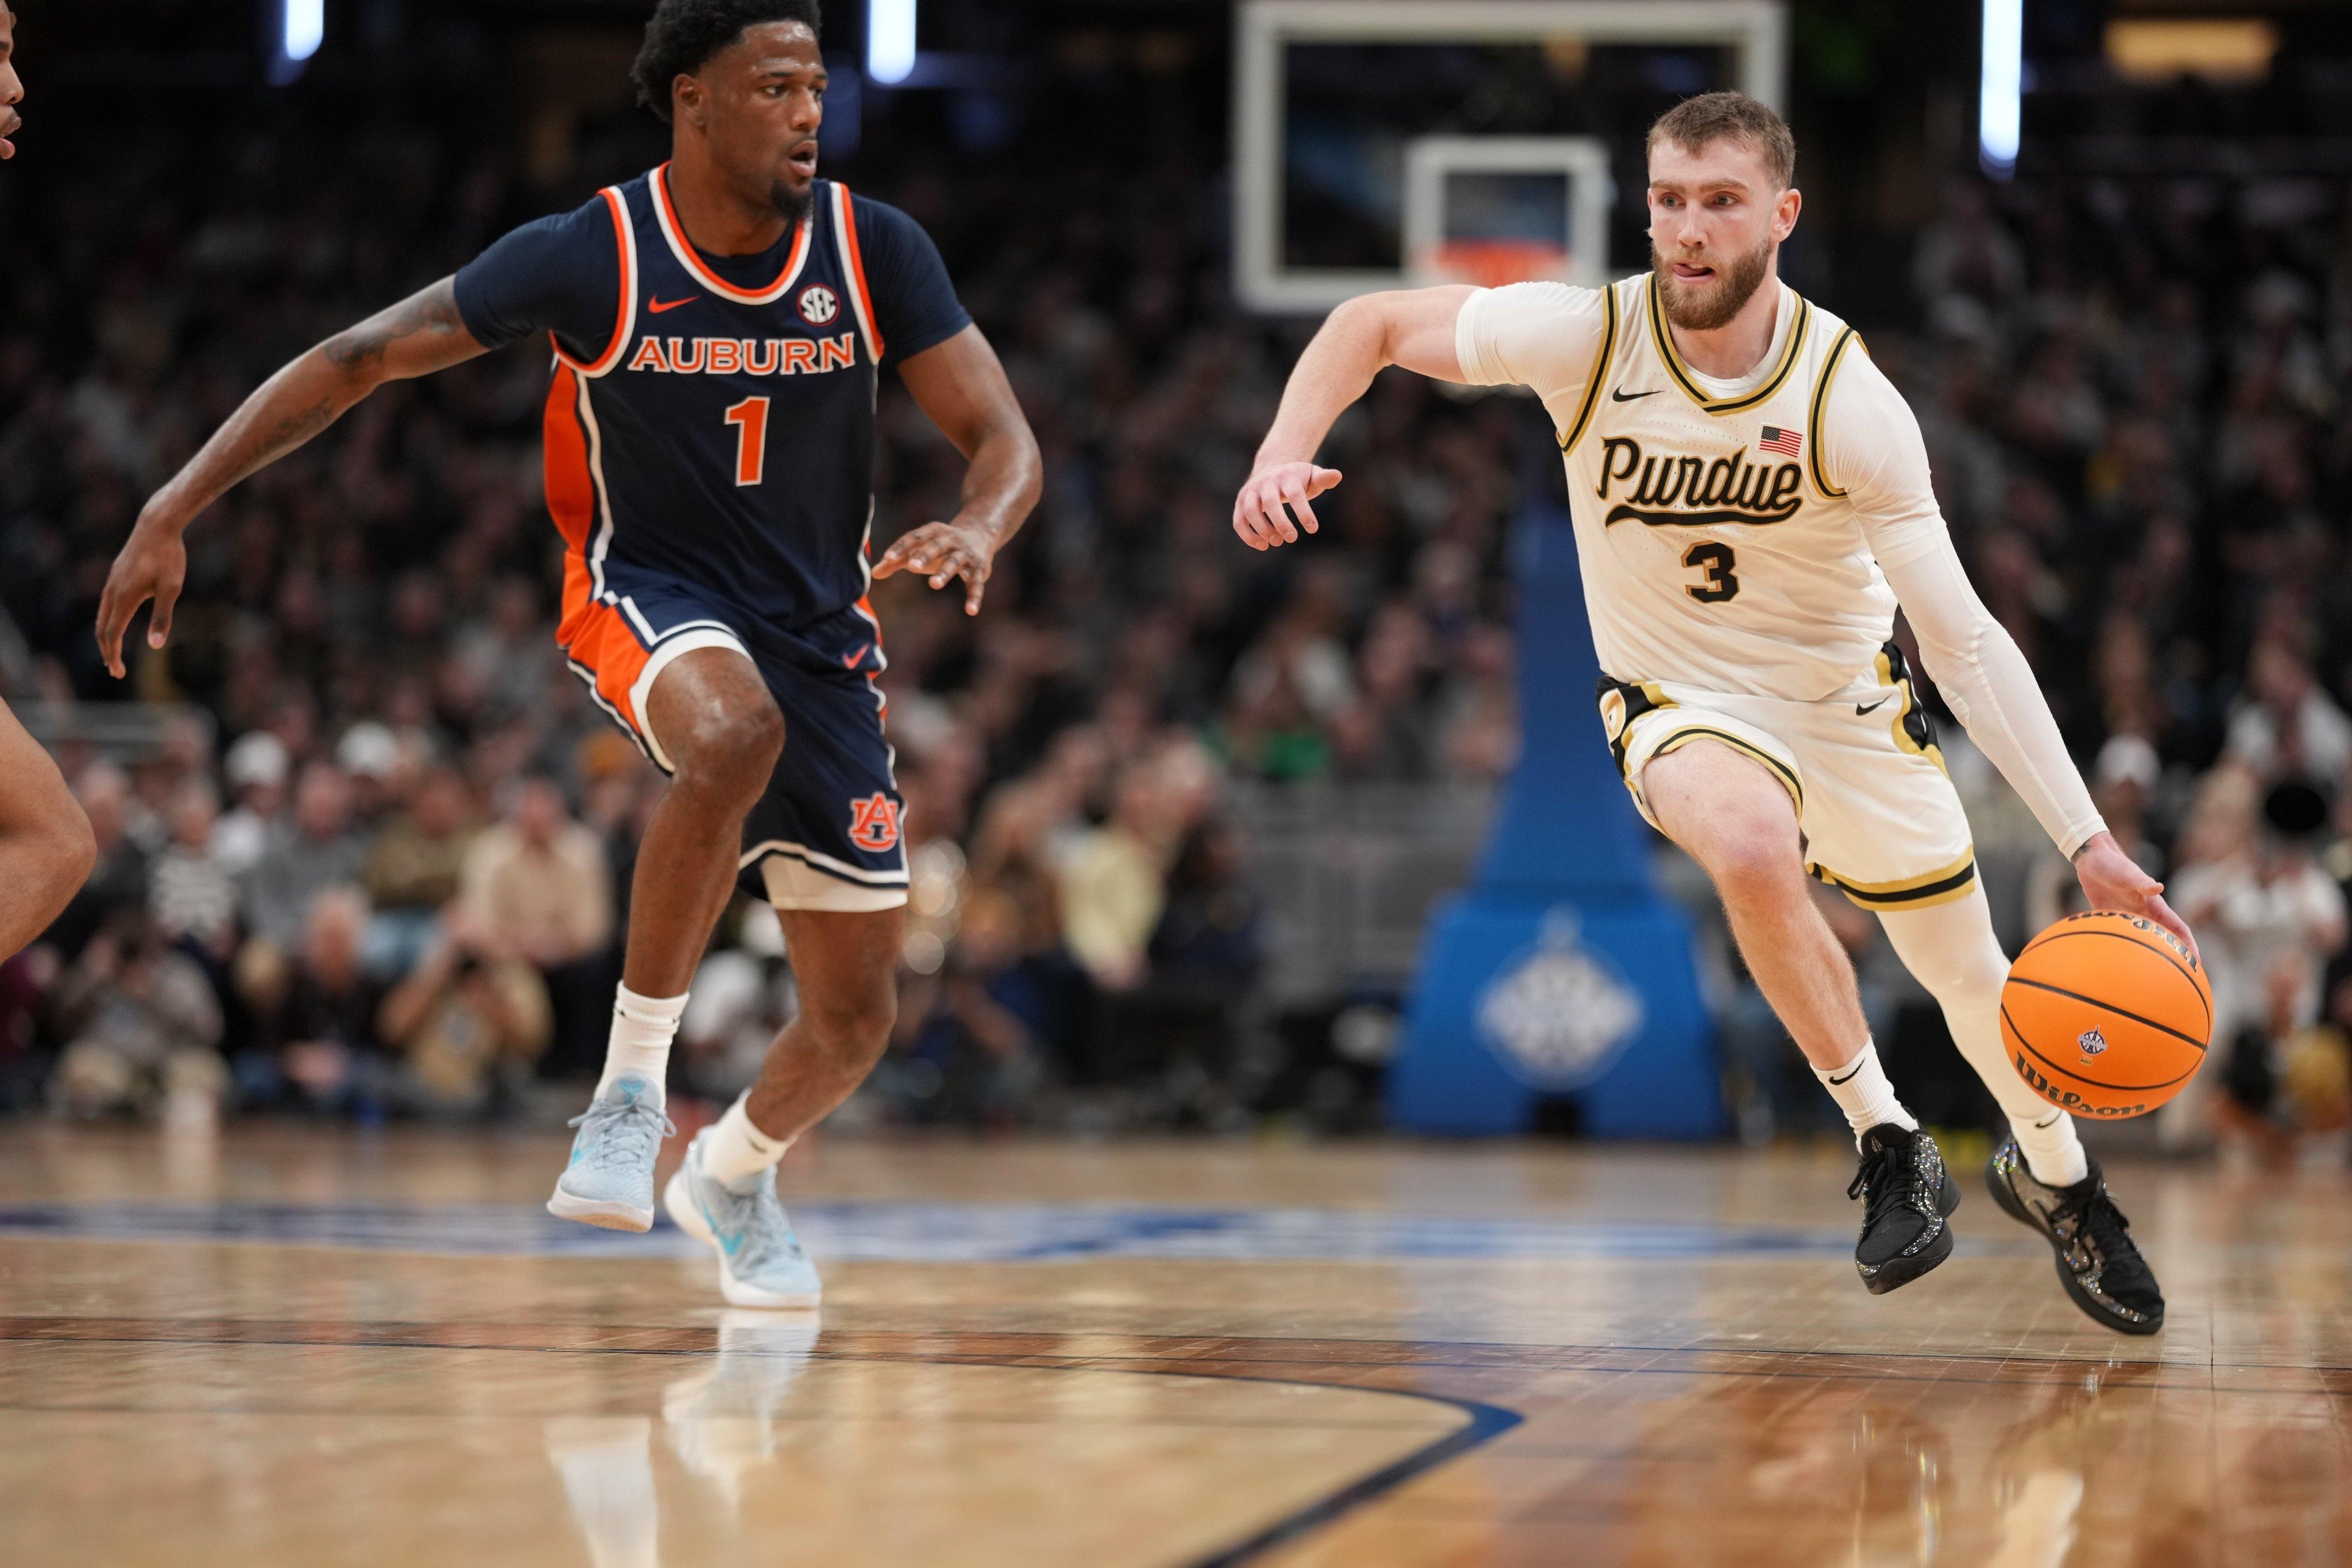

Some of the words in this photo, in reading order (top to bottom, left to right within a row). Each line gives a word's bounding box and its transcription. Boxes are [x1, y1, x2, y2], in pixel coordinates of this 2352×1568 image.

[801, 287, 836, 323] SEC
[627, 331, 856, 374] AUBURN
[724, 396, 771, 487] 1
[1596, 436, 1804, 529] Purdue
[1680, 540, 1739, 603] 3
[2017, 1050, 2146, 1115] Wilson
